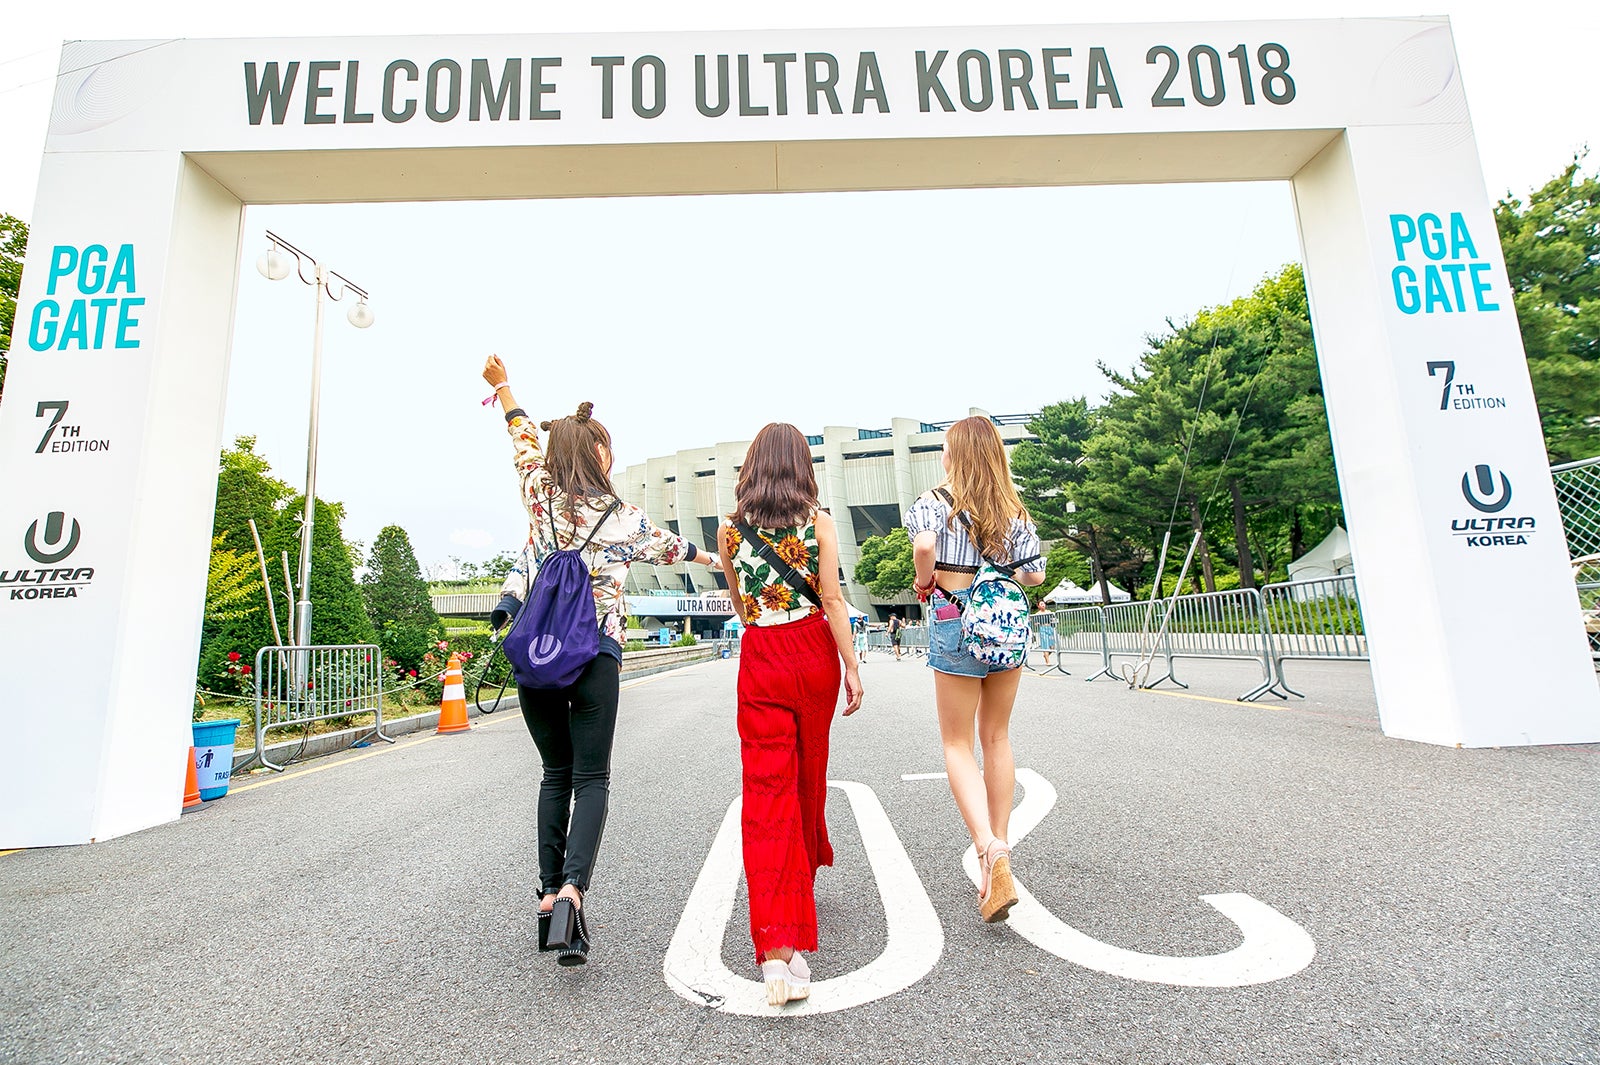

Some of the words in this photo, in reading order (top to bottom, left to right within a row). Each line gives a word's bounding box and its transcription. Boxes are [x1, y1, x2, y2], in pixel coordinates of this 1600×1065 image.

[243, 56, 563, 126] WELCOME
[590, 54, 667, 120] TO
[694, 51, 891, 118] ULTRA
[914, 46, 1124, 113] KOREA
[1145, 42, 1297, 108] 2018
[1389, 211, 1479, 262] PGA
[46, 243, 136, 296] PGA
[1391, 262, 1501, 315] GATE
[28, 297, 146, 352] GATE
[1453, 397, 1506, 410] EDITION
[51, 439, 110, 453] EDITION
[1450, 516, 1536, 532] ULTRA
[1466, 534, 1528, 547] KOREA
[0, 567, 95, 584] ULTRA
[10, 586, 78, 601] KOREA
[677, 599, 704, 612] ULTRA
[706, 599, 733, 612] KOREA
[214, 771, 230, 781] TRAS
